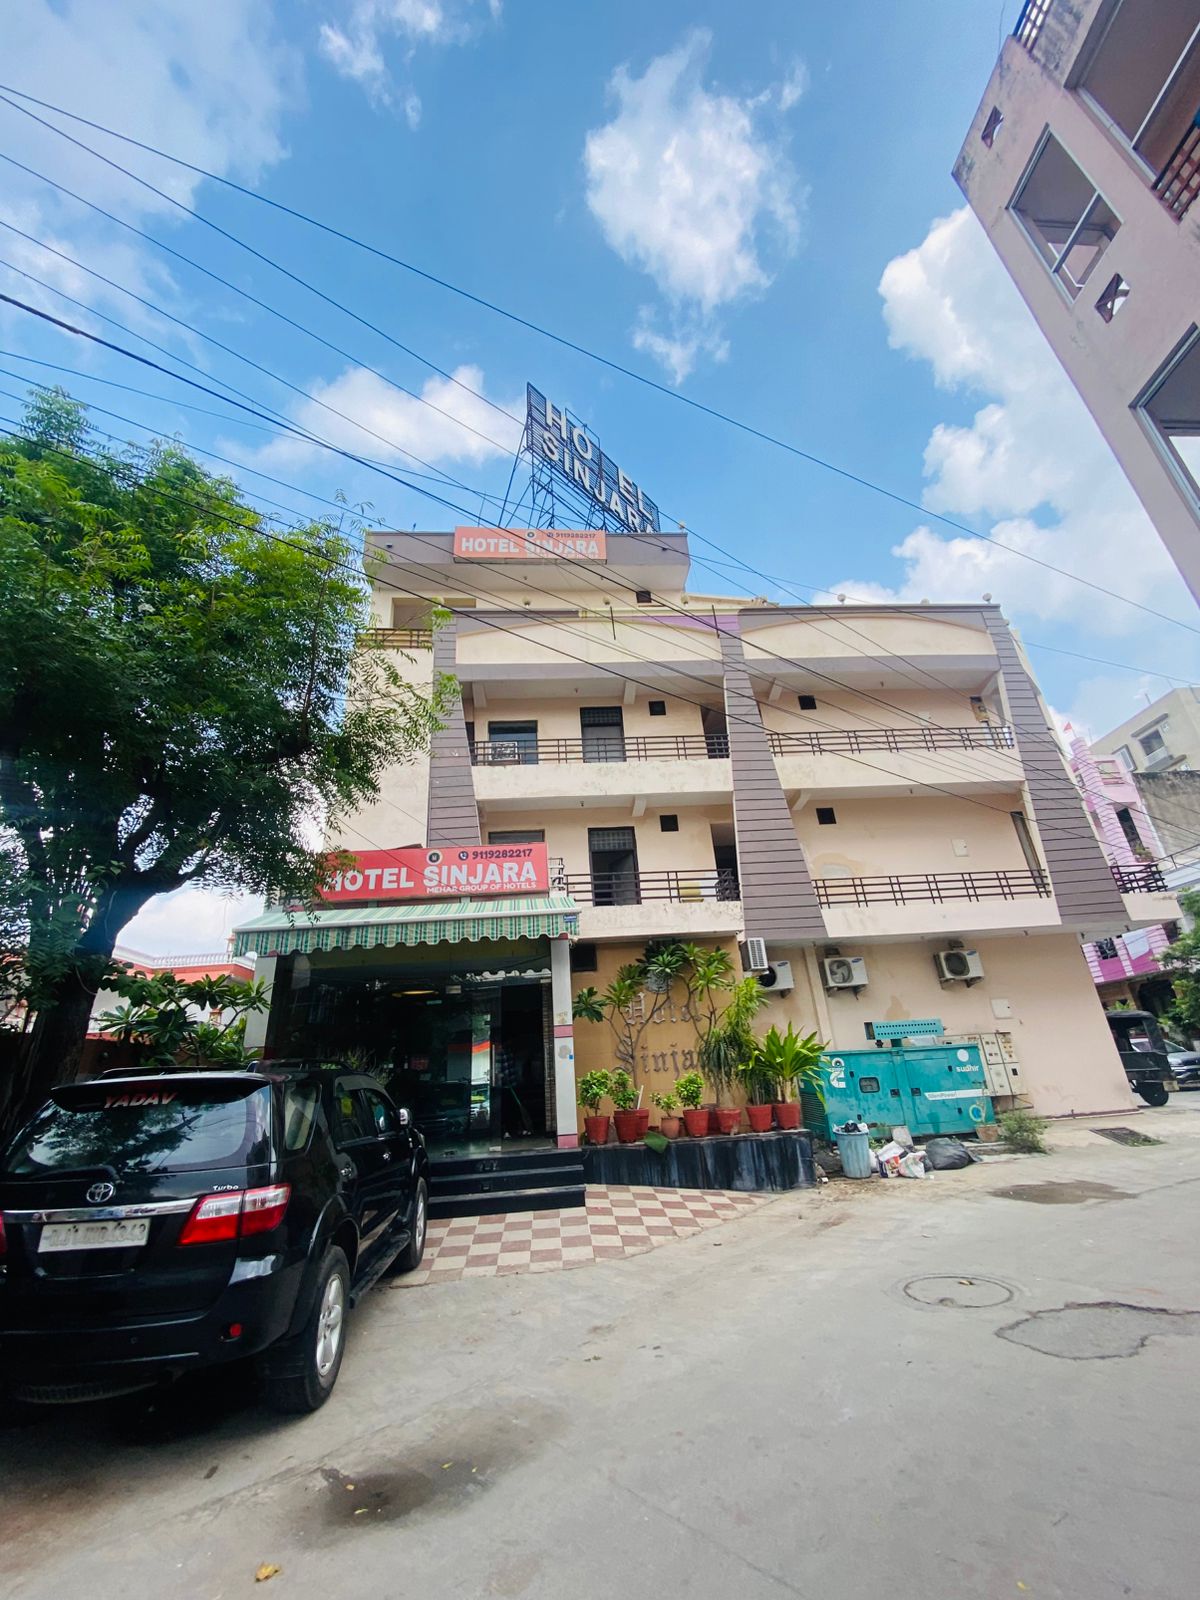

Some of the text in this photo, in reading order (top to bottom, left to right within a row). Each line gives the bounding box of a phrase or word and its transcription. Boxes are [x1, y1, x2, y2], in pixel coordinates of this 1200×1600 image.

[461, 537, 598, 555] HOTEL SINJARA
[472, 848, 533, 860] 9119282217
[323, 861, 537, 892] HOTEL SINJARA
[459, 884, 489, 892] GROUP
[503, 881, 537, 889] HOTELS
[103, 1092, 177, 1109] YADAV
